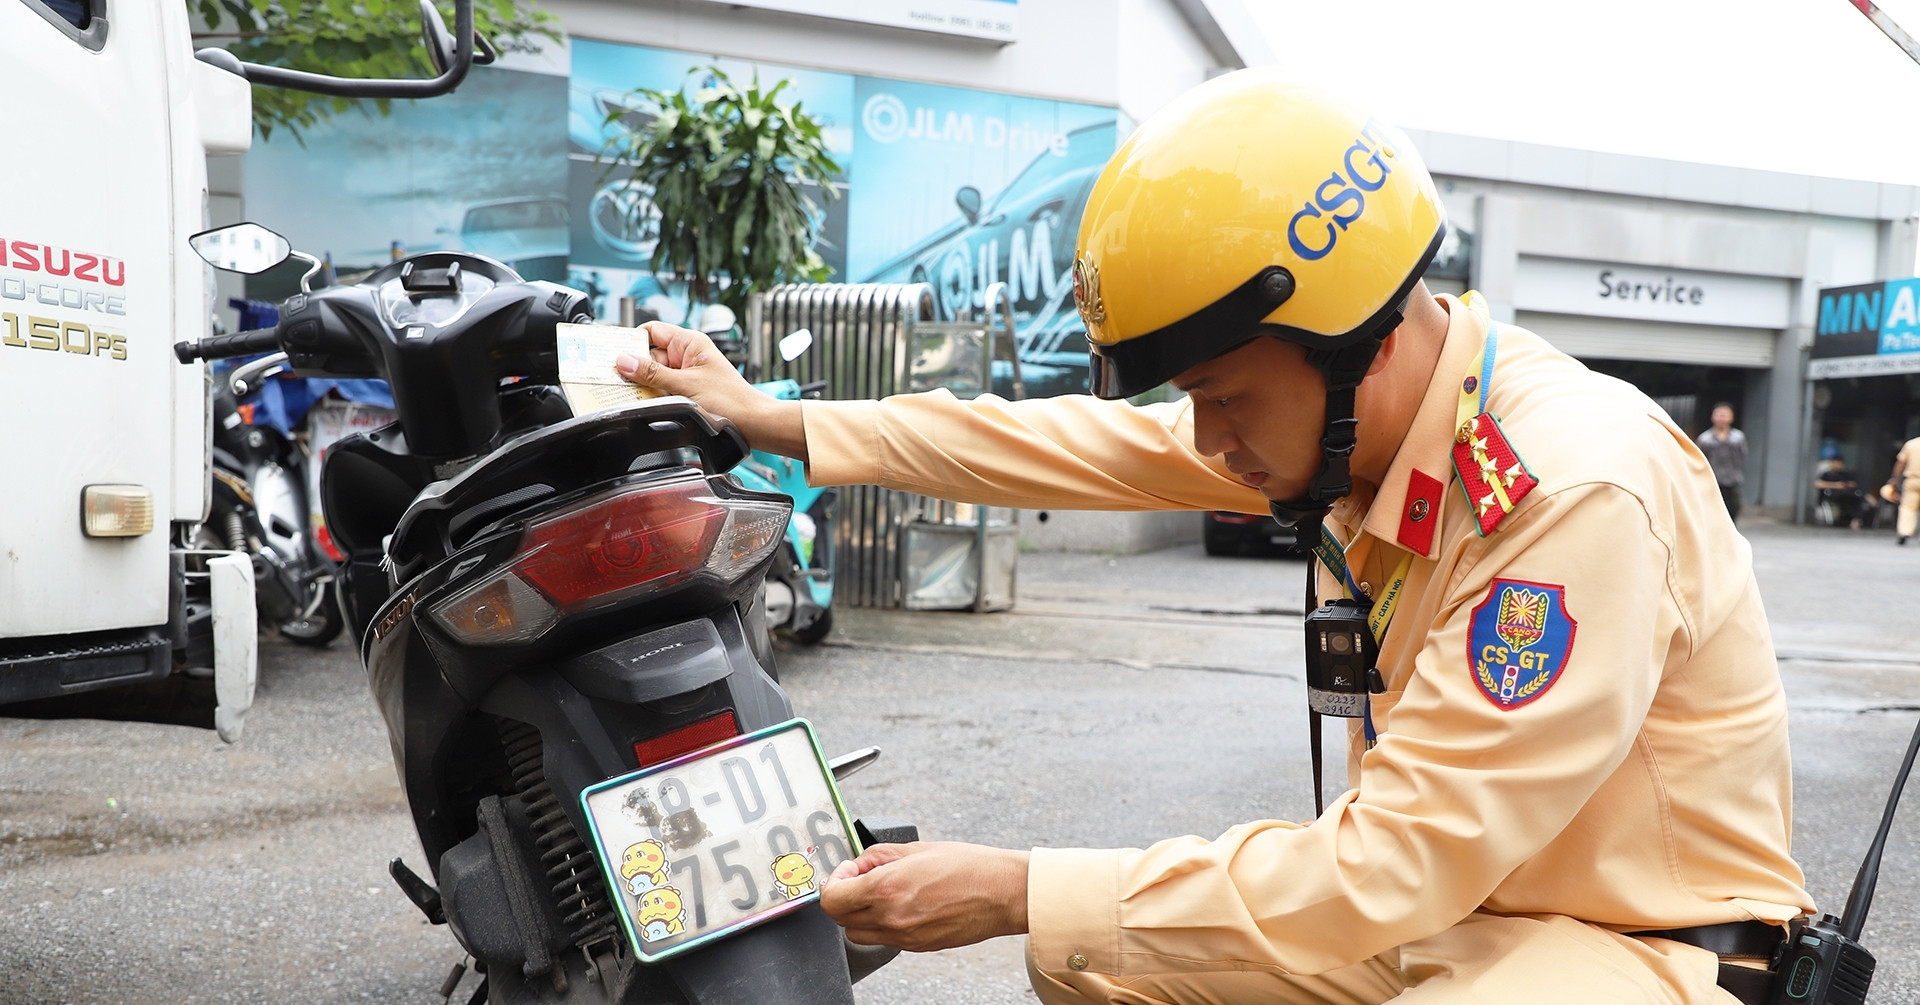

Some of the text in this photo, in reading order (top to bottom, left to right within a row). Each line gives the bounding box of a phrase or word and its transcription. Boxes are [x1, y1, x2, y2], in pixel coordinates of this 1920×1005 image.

[907, 106, 1070, 157] JLM Drive
[0, 238, 125, 287] ISUZU
[1599, 270, 1704, 305] Service
[1818, 286, 1920, 335] MN A
[1378, 600, 1391, 617] CATP
[1507, 627, 1532, 637] CAND
[1482, 644, 1549, 670] CS GT
